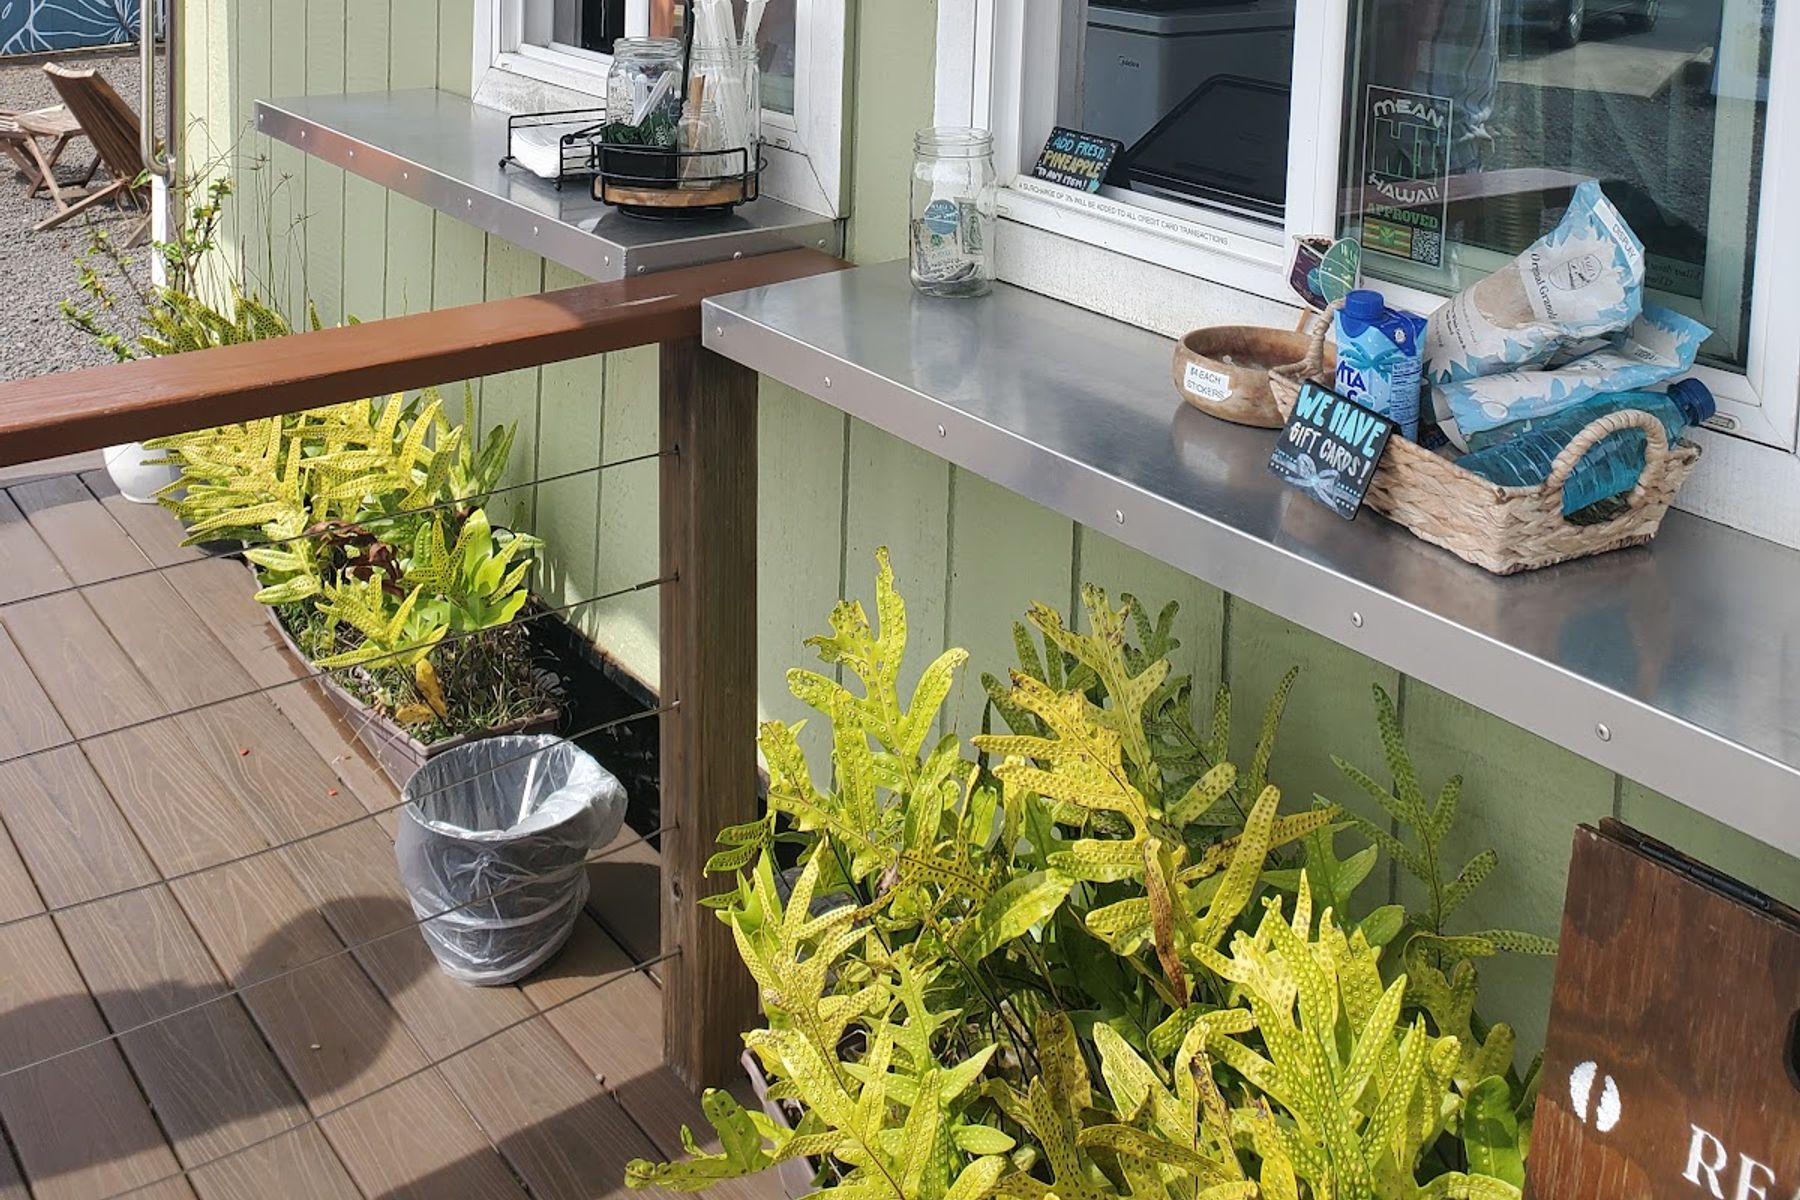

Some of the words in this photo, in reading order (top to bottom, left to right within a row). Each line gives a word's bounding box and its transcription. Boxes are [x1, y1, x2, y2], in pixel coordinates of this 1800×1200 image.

[1373, 98, 1444, 129] MEAN
[1052, 135, 1074, 152] ADD
[1042, 150, 1104, 178] PINEAPPLE
[1046, 170, 1063, 183] ANY
[1368, 172, 1440, 204] HAWAII
[1117, 208, 1126, 218] TO
[1366, 202, 1439, 229] APPROVED
[1295, 384, 1334, 427] WE
[1328, 403, 1387, 458] HAVE
[1289, 421, 1323, 454] GIFT
